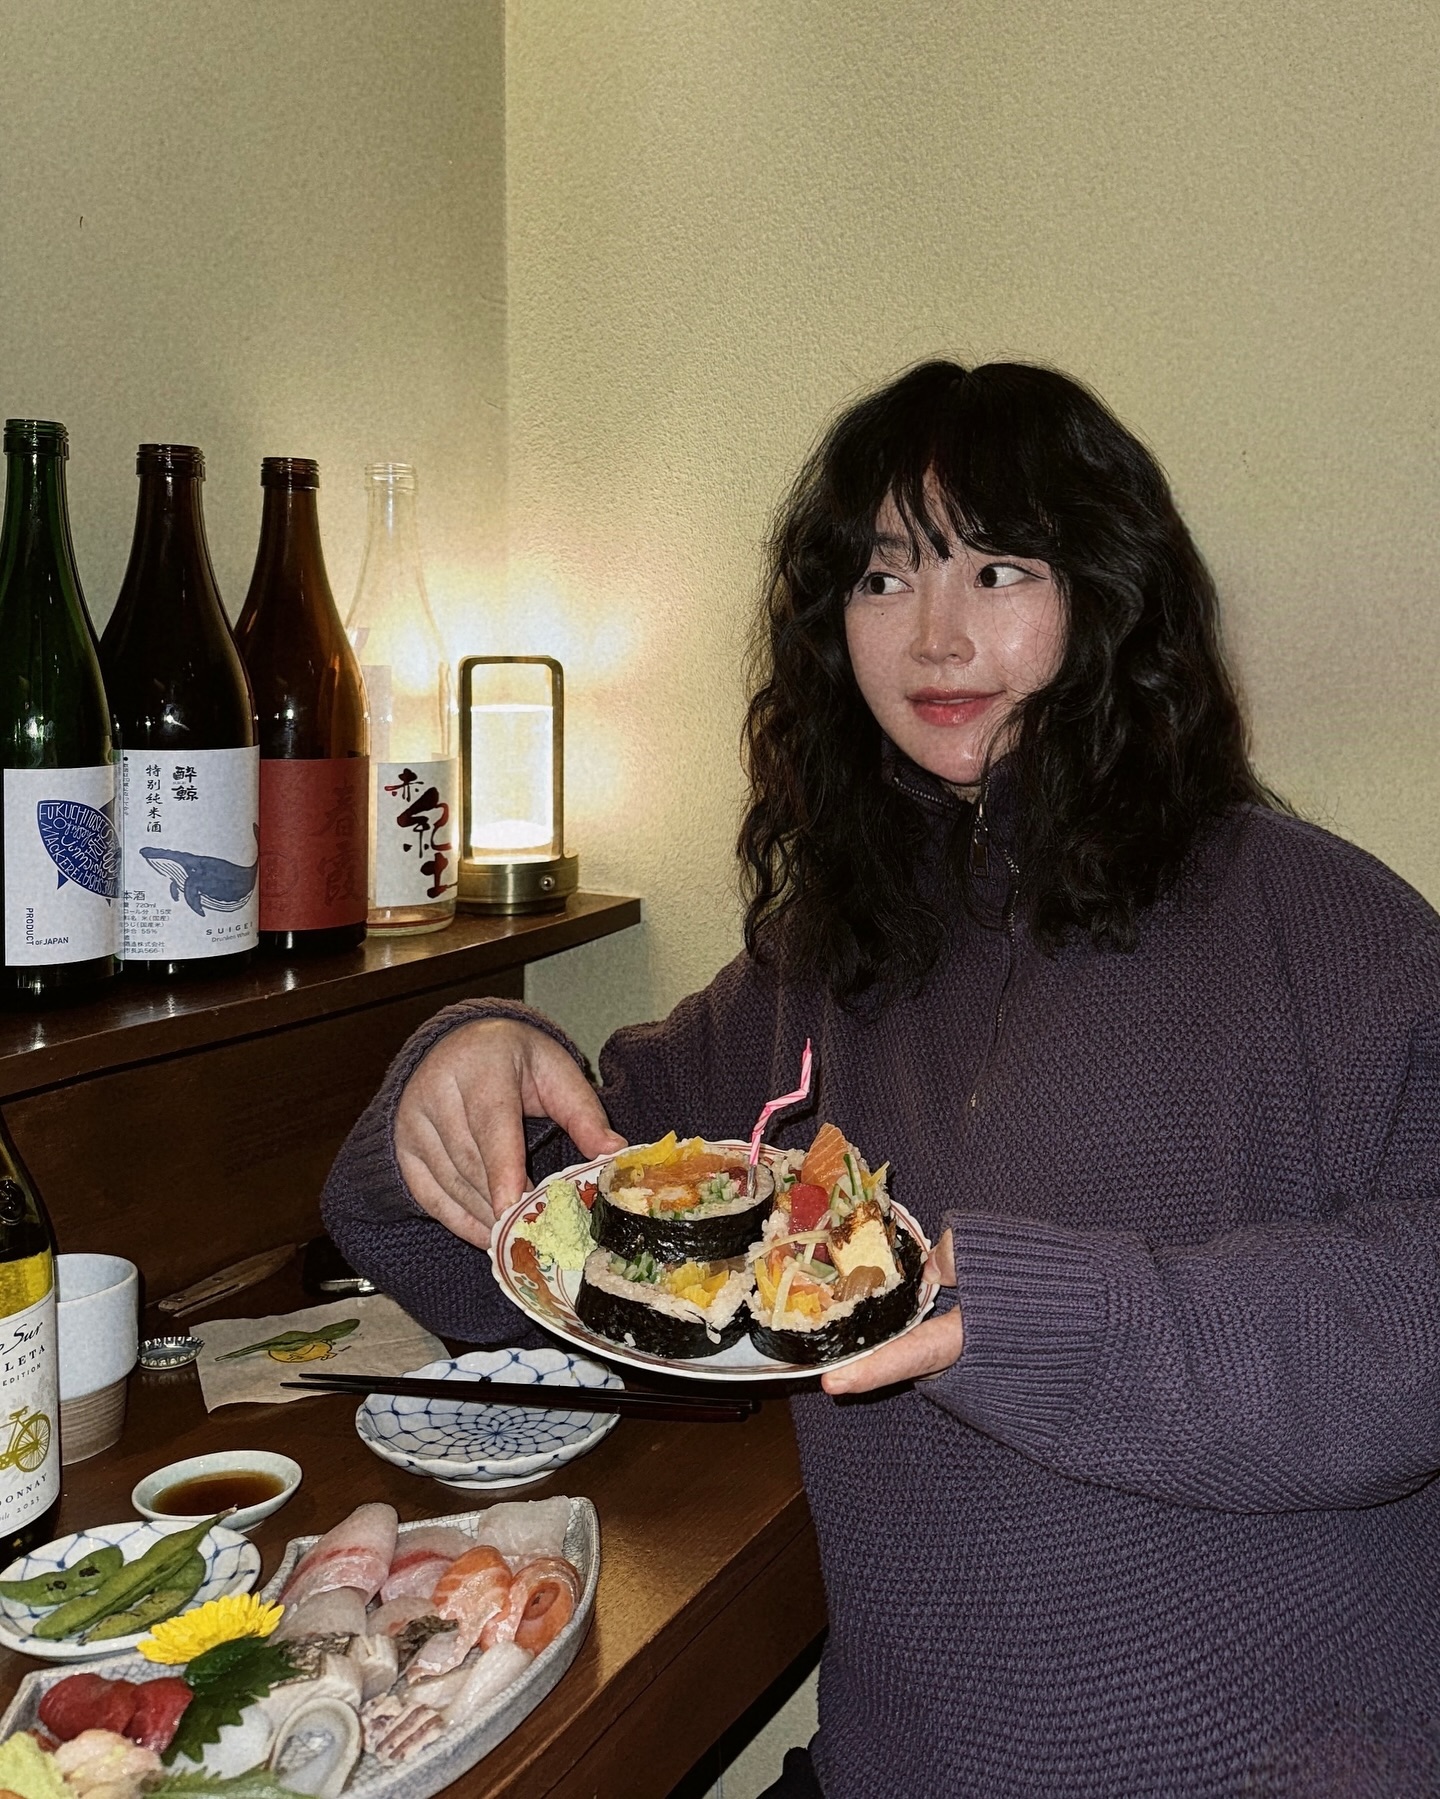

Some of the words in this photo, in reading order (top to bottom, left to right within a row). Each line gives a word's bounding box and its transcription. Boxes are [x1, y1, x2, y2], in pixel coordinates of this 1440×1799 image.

[145, 764, 163, 833] 特別純米酒
[171, 765, 199, 801] 酔鯨
[41, 821, 84, 884] MACKEREL
[26, 907, 34, 946] PRODUCT
[43, 936, 69, 945] JAPAN
[206, 921, 253, 936] SUIGEI
[2, 1322, 43, 1355] Sur
[2, 1362, 41, 1387] EDITION
[5, 1344, 45, 1372] LETA
[0, 1472, 47, 1506] ONNAY
